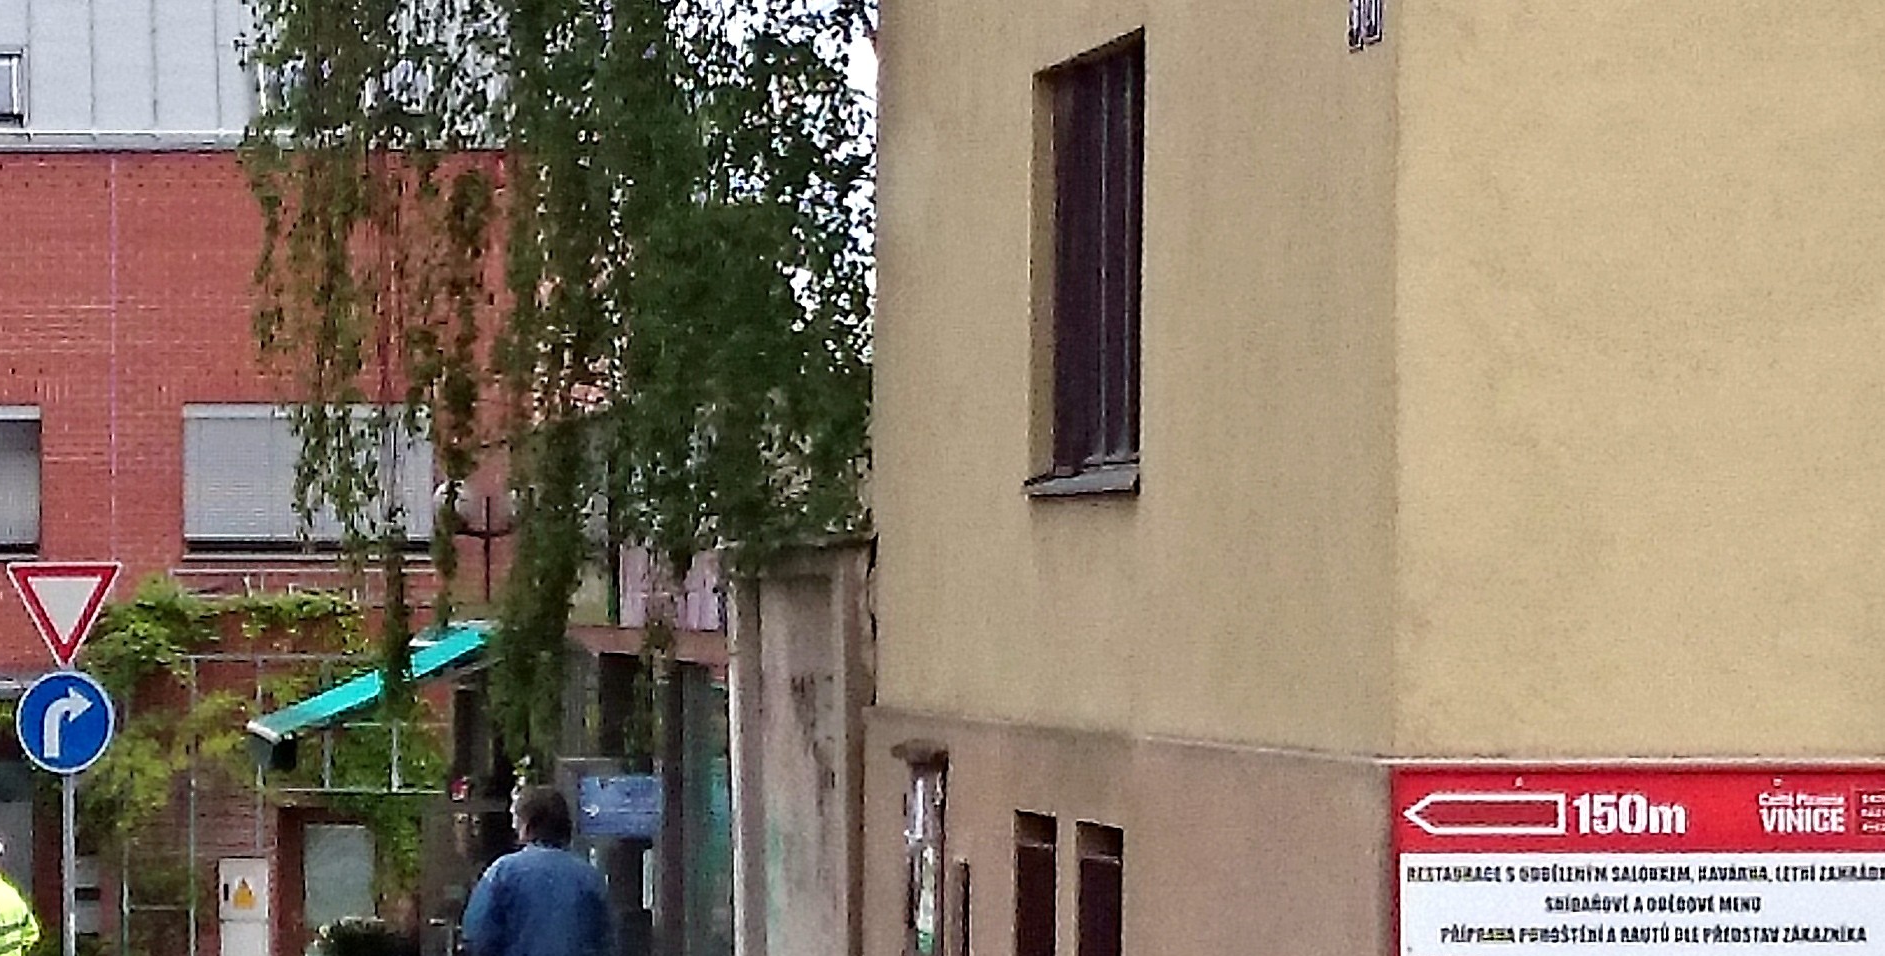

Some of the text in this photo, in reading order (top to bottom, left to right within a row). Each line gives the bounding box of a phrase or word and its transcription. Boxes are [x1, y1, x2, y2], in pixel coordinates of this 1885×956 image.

[1573, 792, 1688, 834] 150m
[1759, 807, 1846, 833] VINICE
[1407, 865, 1502, 882] RESTAURACE
[1506, 866, 1515, 882] S
[1633, 896, 1644, 913] A
[1719, 896, 1762, 913] MENU
[1606, 927, 1617, 943] A
